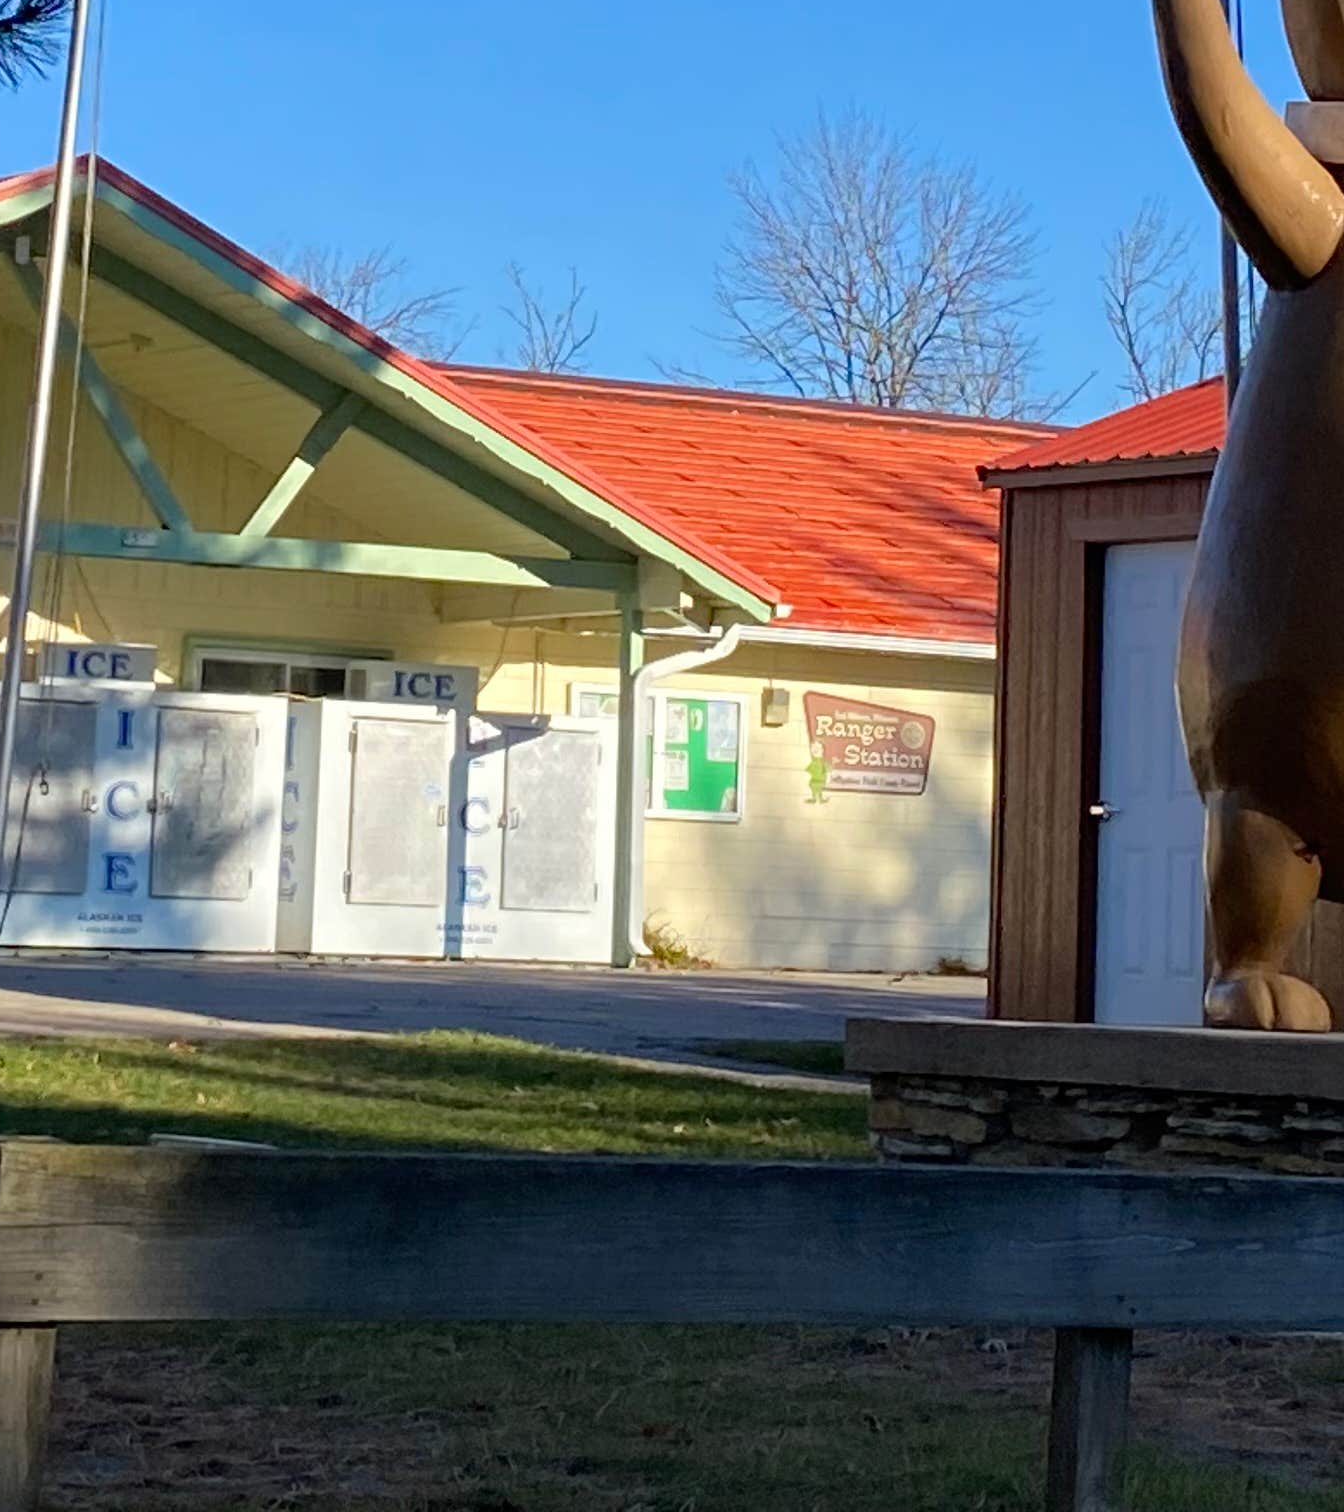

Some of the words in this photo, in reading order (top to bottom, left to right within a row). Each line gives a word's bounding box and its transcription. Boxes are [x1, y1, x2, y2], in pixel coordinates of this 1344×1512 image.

[66, 650, 133, 680] ICE
[393, 670, 457, 701] ICE
[816, 716, 897, 745] Ranger
[844, 745, 924, 769] Station
[102, 710, 139, 894] ICE
